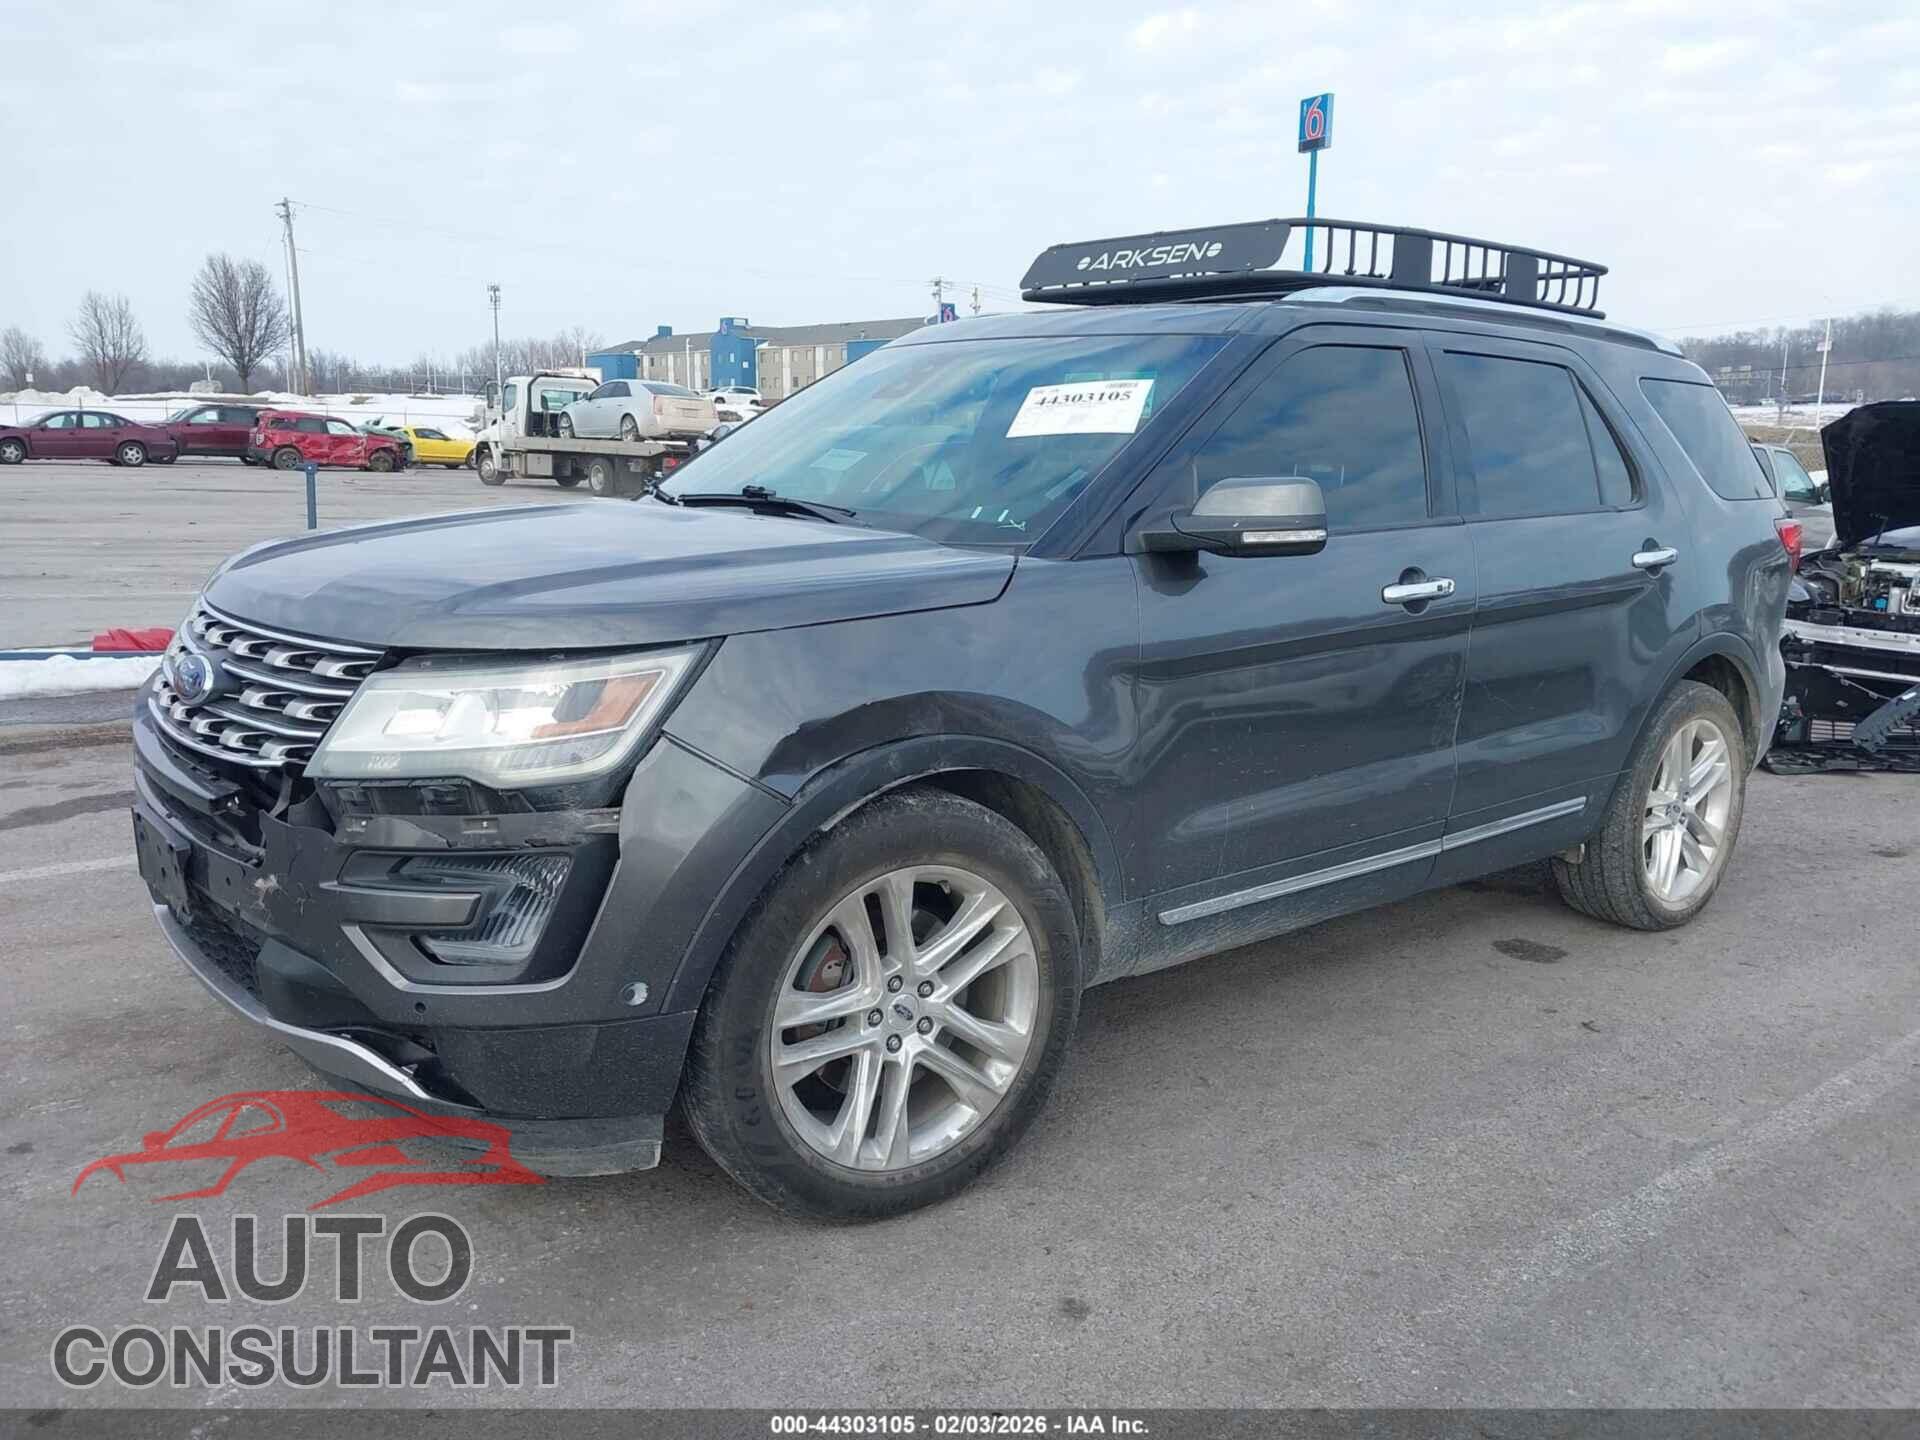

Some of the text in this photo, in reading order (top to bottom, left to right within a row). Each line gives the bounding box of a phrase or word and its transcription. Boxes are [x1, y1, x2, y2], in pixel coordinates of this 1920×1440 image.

[1305, 96, 1324, 140] 6
[1088, 241, 1210, 271] ARKSEN
[1034, 390, 1133, 406] 44303105
